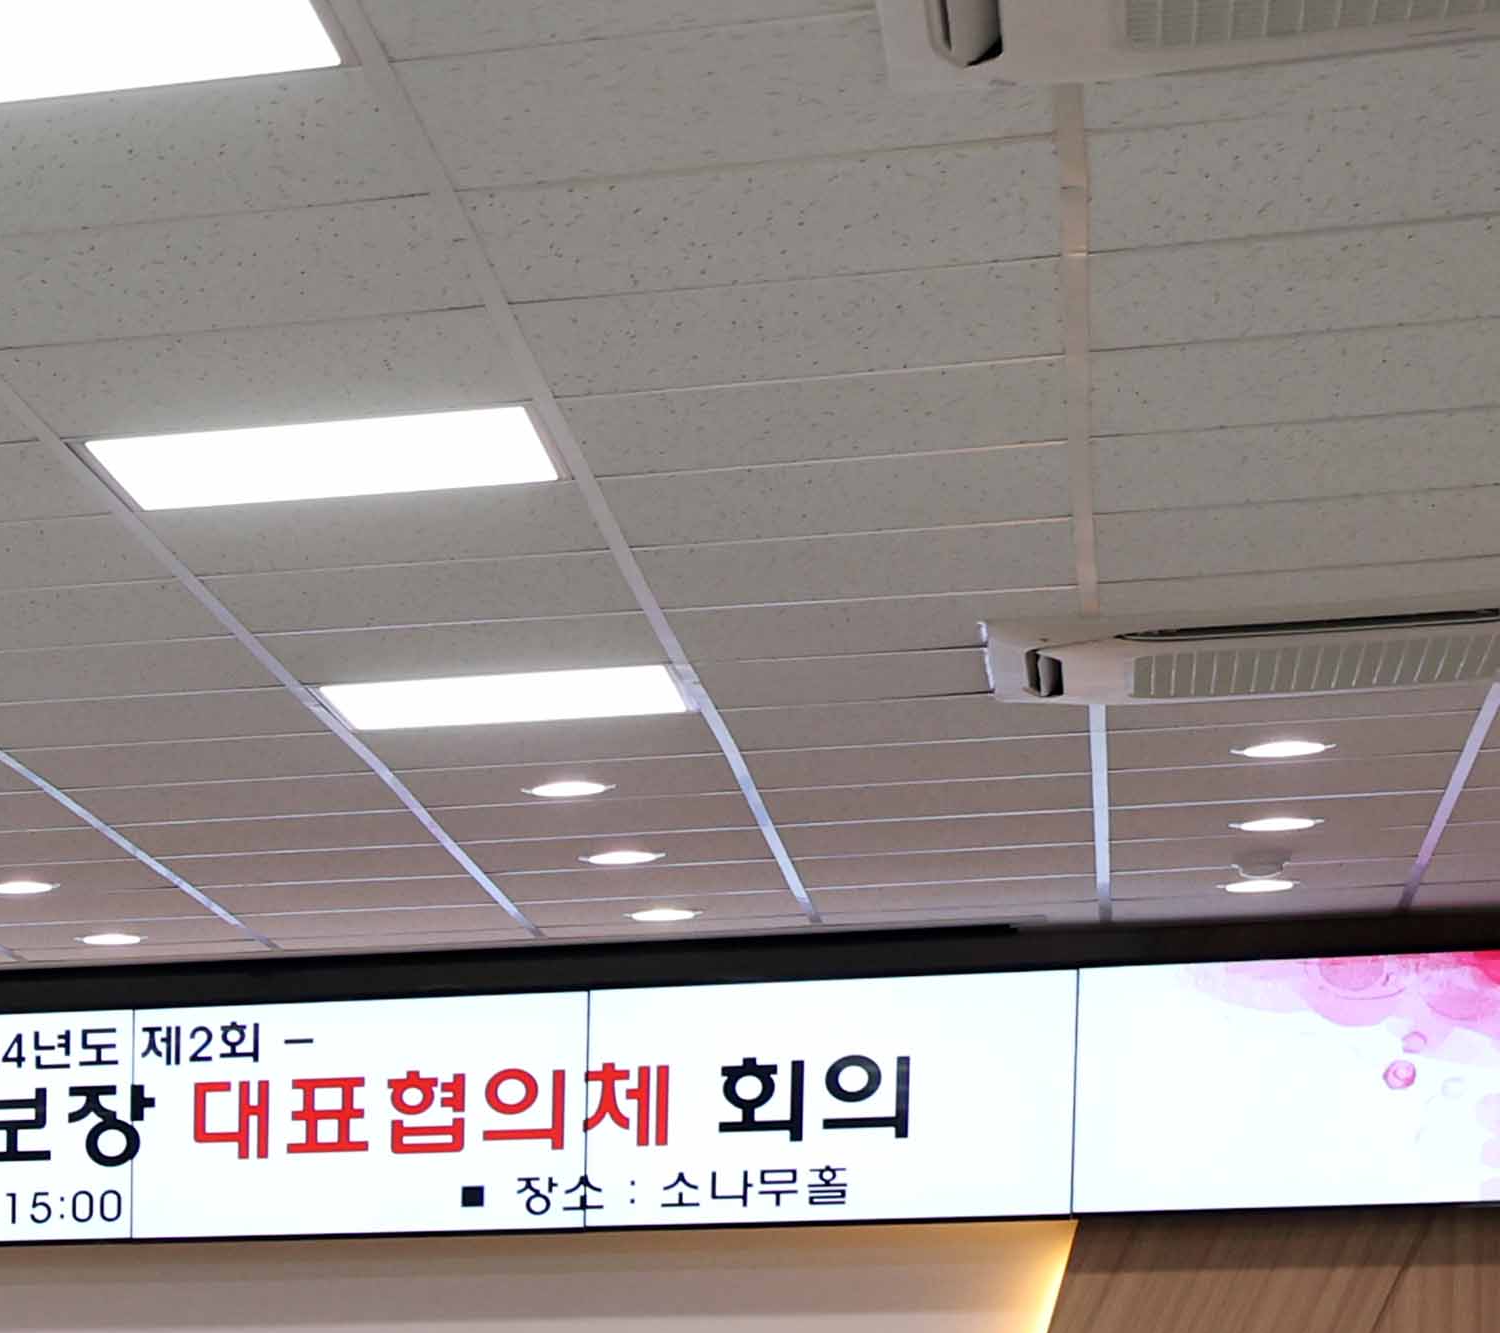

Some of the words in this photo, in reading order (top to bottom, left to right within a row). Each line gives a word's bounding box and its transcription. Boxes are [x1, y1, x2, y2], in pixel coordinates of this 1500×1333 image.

[141, 1021, 260, 1066] 제2회
[191, 1063, 670, 1160] 대표협의체
[718, 1054, 911, 1143] 회의
[6, 1189, 122, 1225] 15:00
[516, 1176, 604, 1215] 장소
[660, 1165, 848, 1208] 소나무홀
